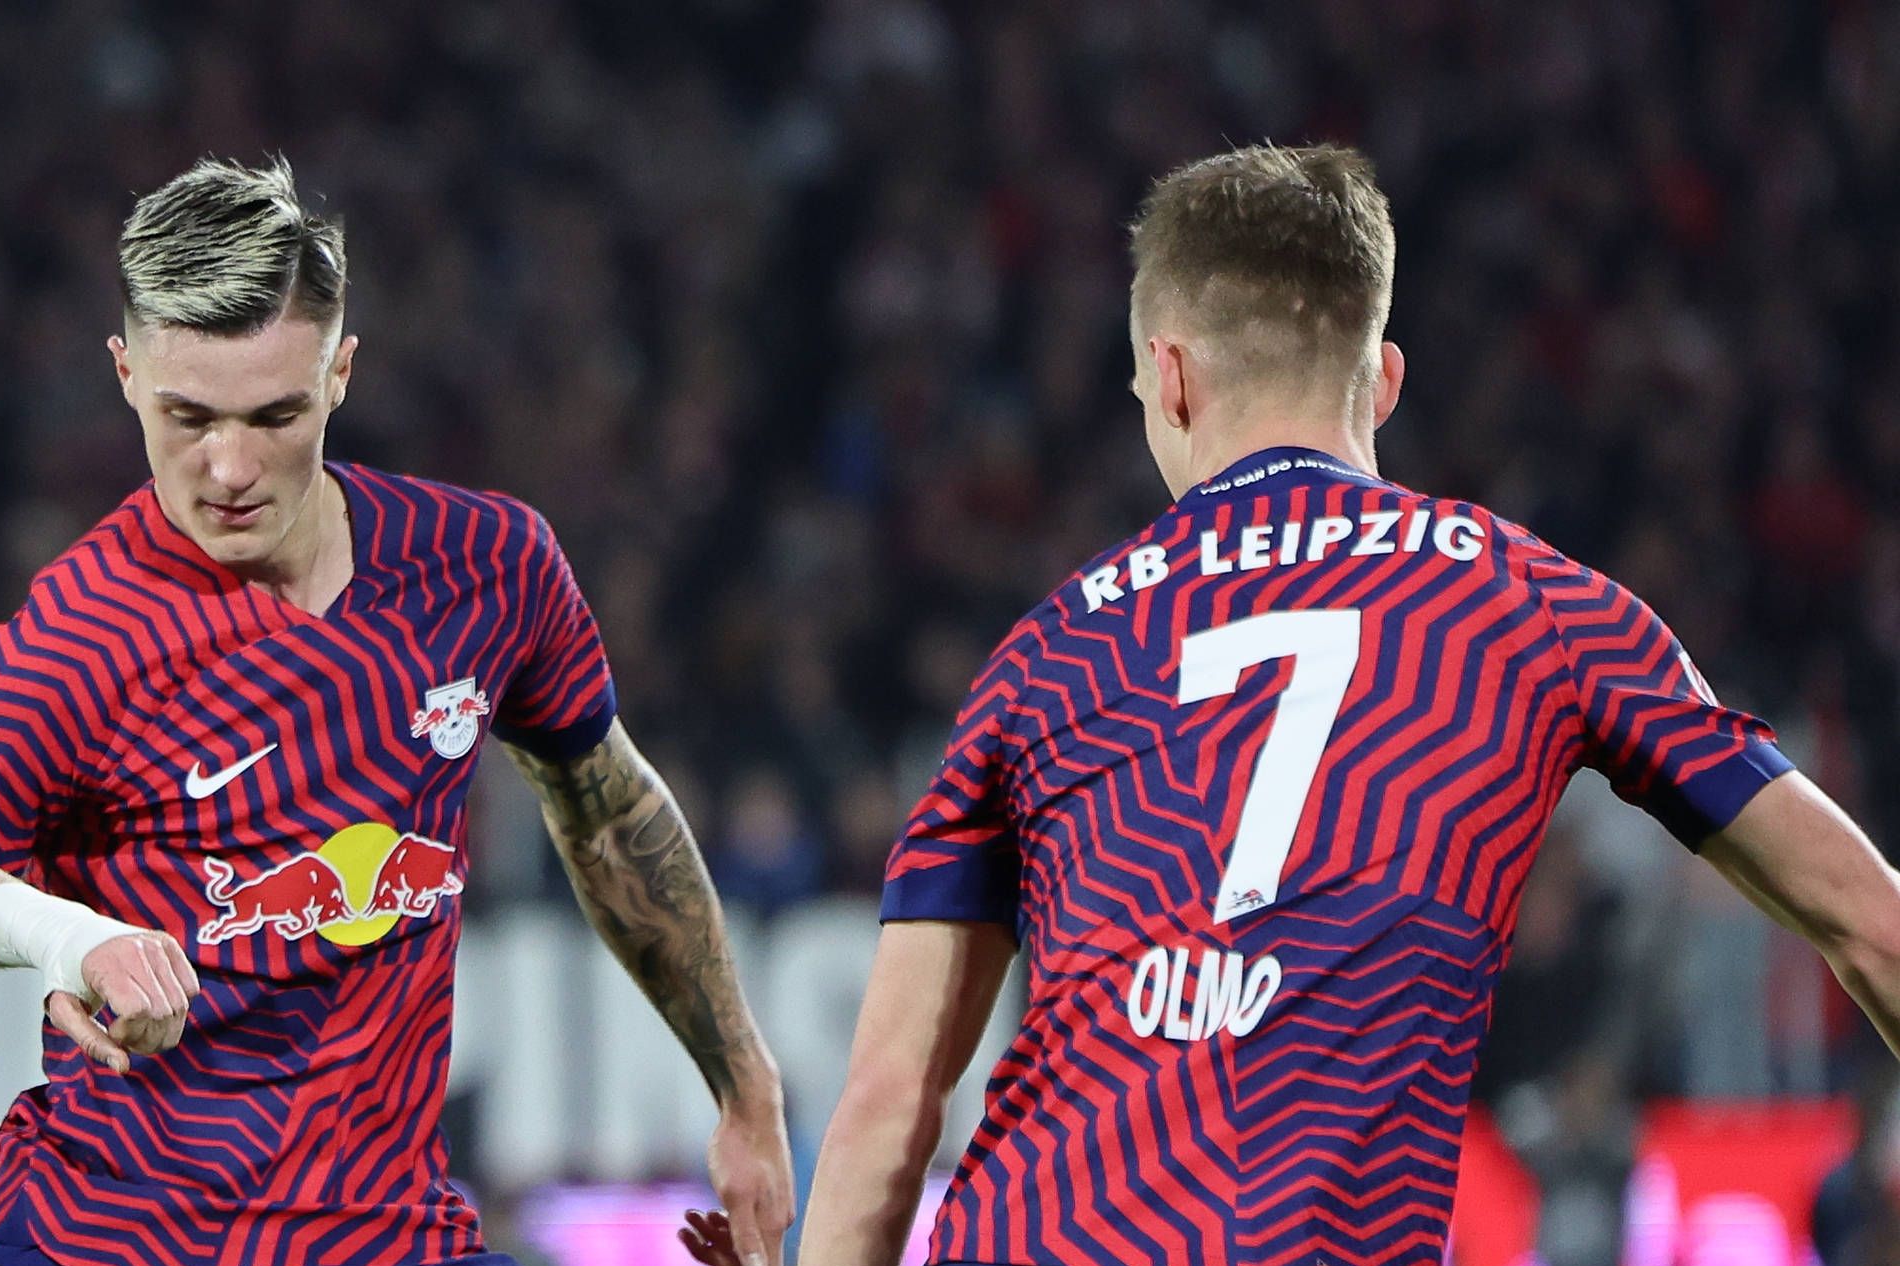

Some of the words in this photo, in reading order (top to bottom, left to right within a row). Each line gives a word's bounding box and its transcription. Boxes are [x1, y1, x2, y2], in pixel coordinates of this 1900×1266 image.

[1200, 480, 1231, 496] YOU
[1233, 468, 1266, 488] CAN
[1268, 459, 1292, 476] DO
[1081, 545, 1169, 614] RB
[1200, 511, 1486, 576] LEIPZIG
[1178, 608, 1362, 926] 7
[1127, 944, 1282, 1042] OLMO
